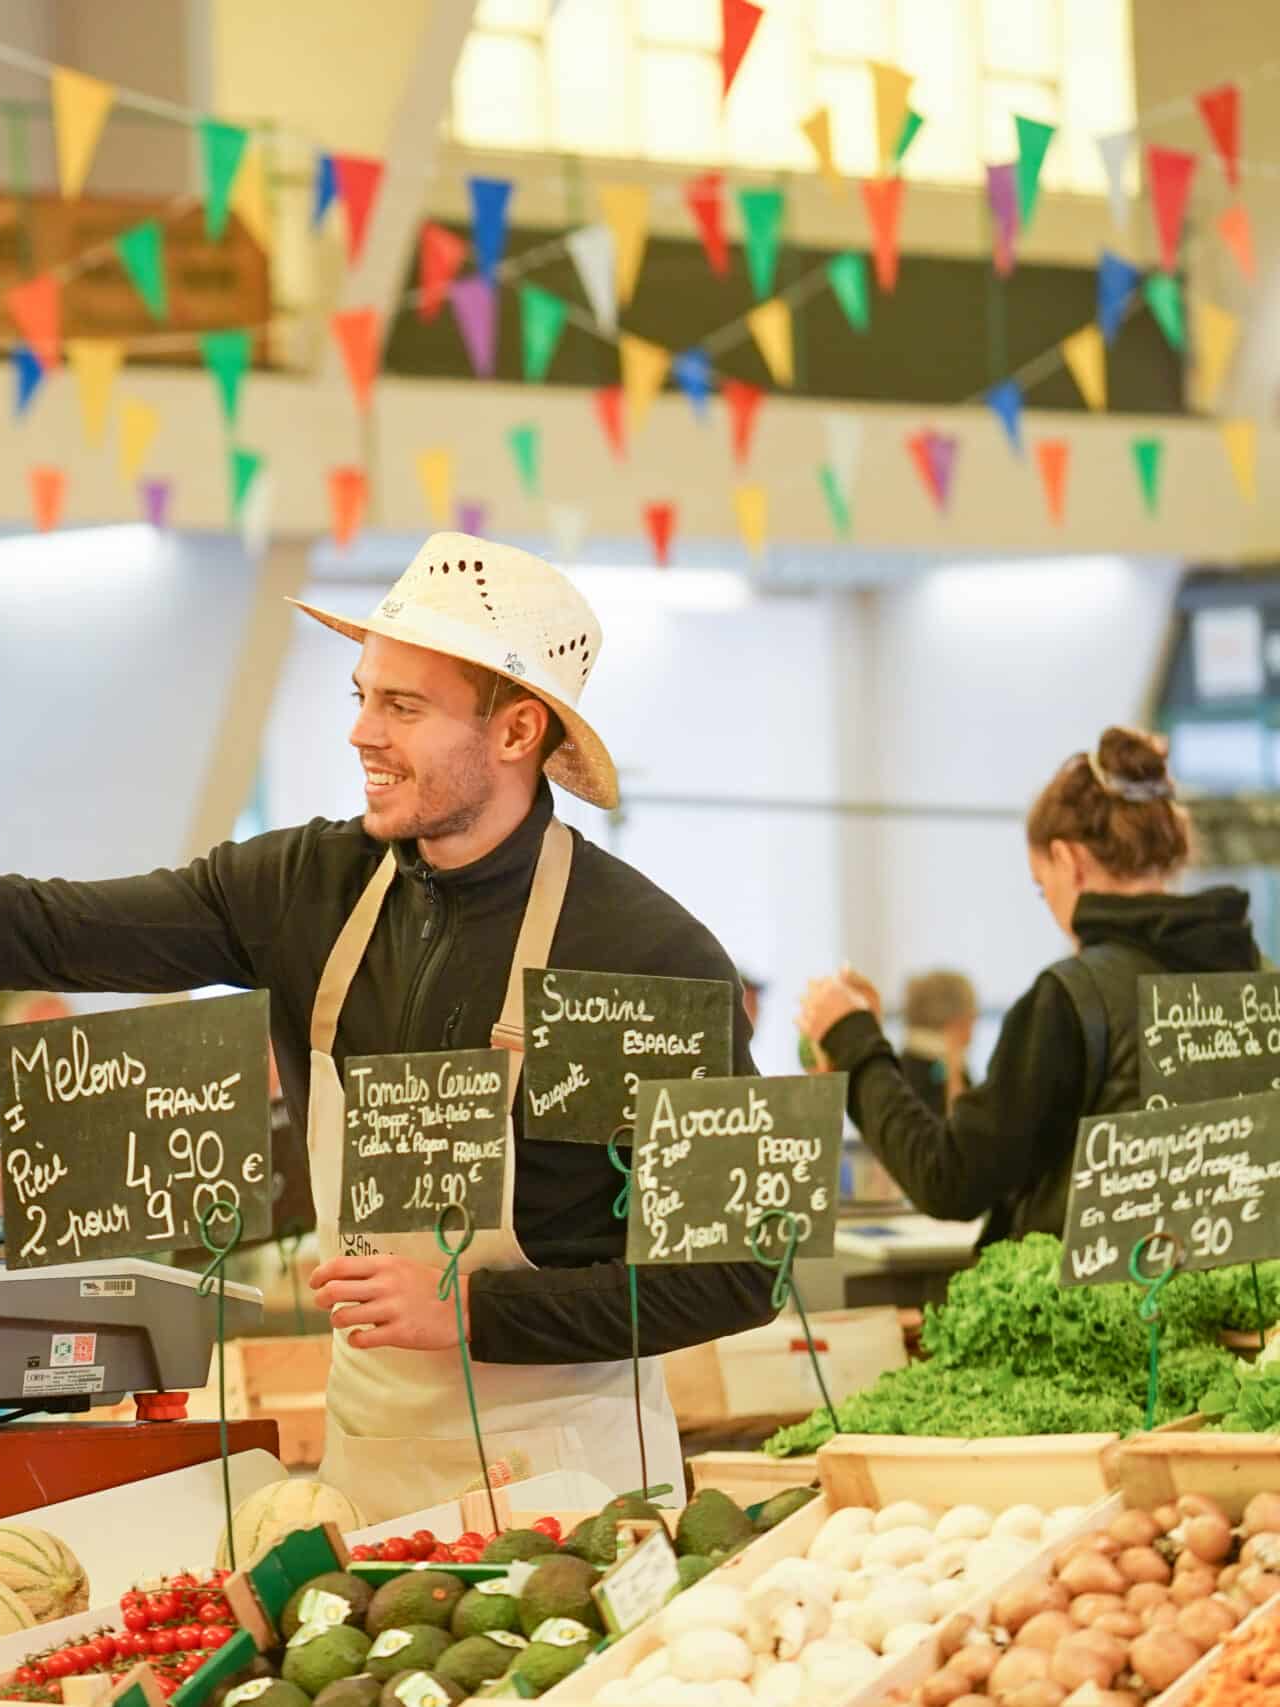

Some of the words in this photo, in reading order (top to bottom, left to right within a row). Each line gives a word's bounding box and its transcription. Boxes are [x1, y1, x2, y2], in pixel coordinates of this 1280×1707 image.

[541, 974, 655, 1023] Sucrine
[11, 1026, 146, 1102] Melons
[622, 1029, 704, 1055] ESPAGNE
[1177, 1029, 1242, 1062] Feuille
[146, 1073, 241, 1119] FRANCE
[350, 1062, 430, 1107] Tomates
[438, 1062, 501, 1099] Cerises
[650, 1088, 774, 1141] Avocats
[452, 1137, 505, 1163] FRANCE
[757, 1135, 821, 1167] PEROU
[1086, 1116, 1254, 1179] Champignons
[351, 1176, 384, 1223] Kilo
[1100, 1169, 1158, 1197] blancs
[21, 1205, 47, 1258] 2
[57, 1204, 130, 1257] pour
[1080, 1207, 1105, 1228] En
[1112, 1193, 1164, 1222] direct
[648, 1219, 670, 1260] 2
[671, 1221, 728, 1262] pour
[1072, 1235, 1119, 1279] Kilo
